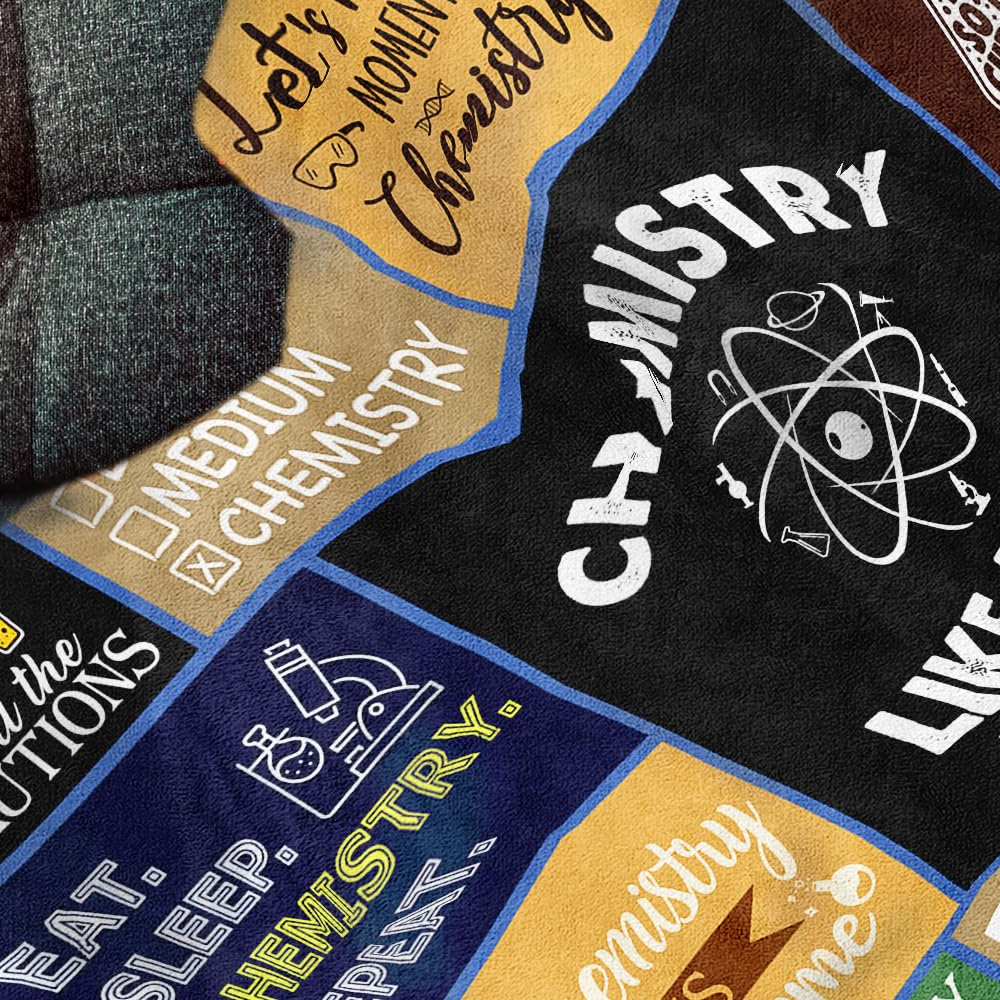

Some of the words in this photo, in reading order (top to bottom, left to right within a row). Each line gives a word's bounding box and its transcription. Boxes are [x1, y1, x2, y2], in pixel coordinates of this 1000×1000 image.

[198, 8, 348, 155] Let's
[953, 2, 993, 56] SO
[140, 346, 352, 518] MEDIUM
[219, 320, 468, 546] CHEMISTRY
[10, 632, 83, 706] the
[0, 858, 168, 993] EAT.
